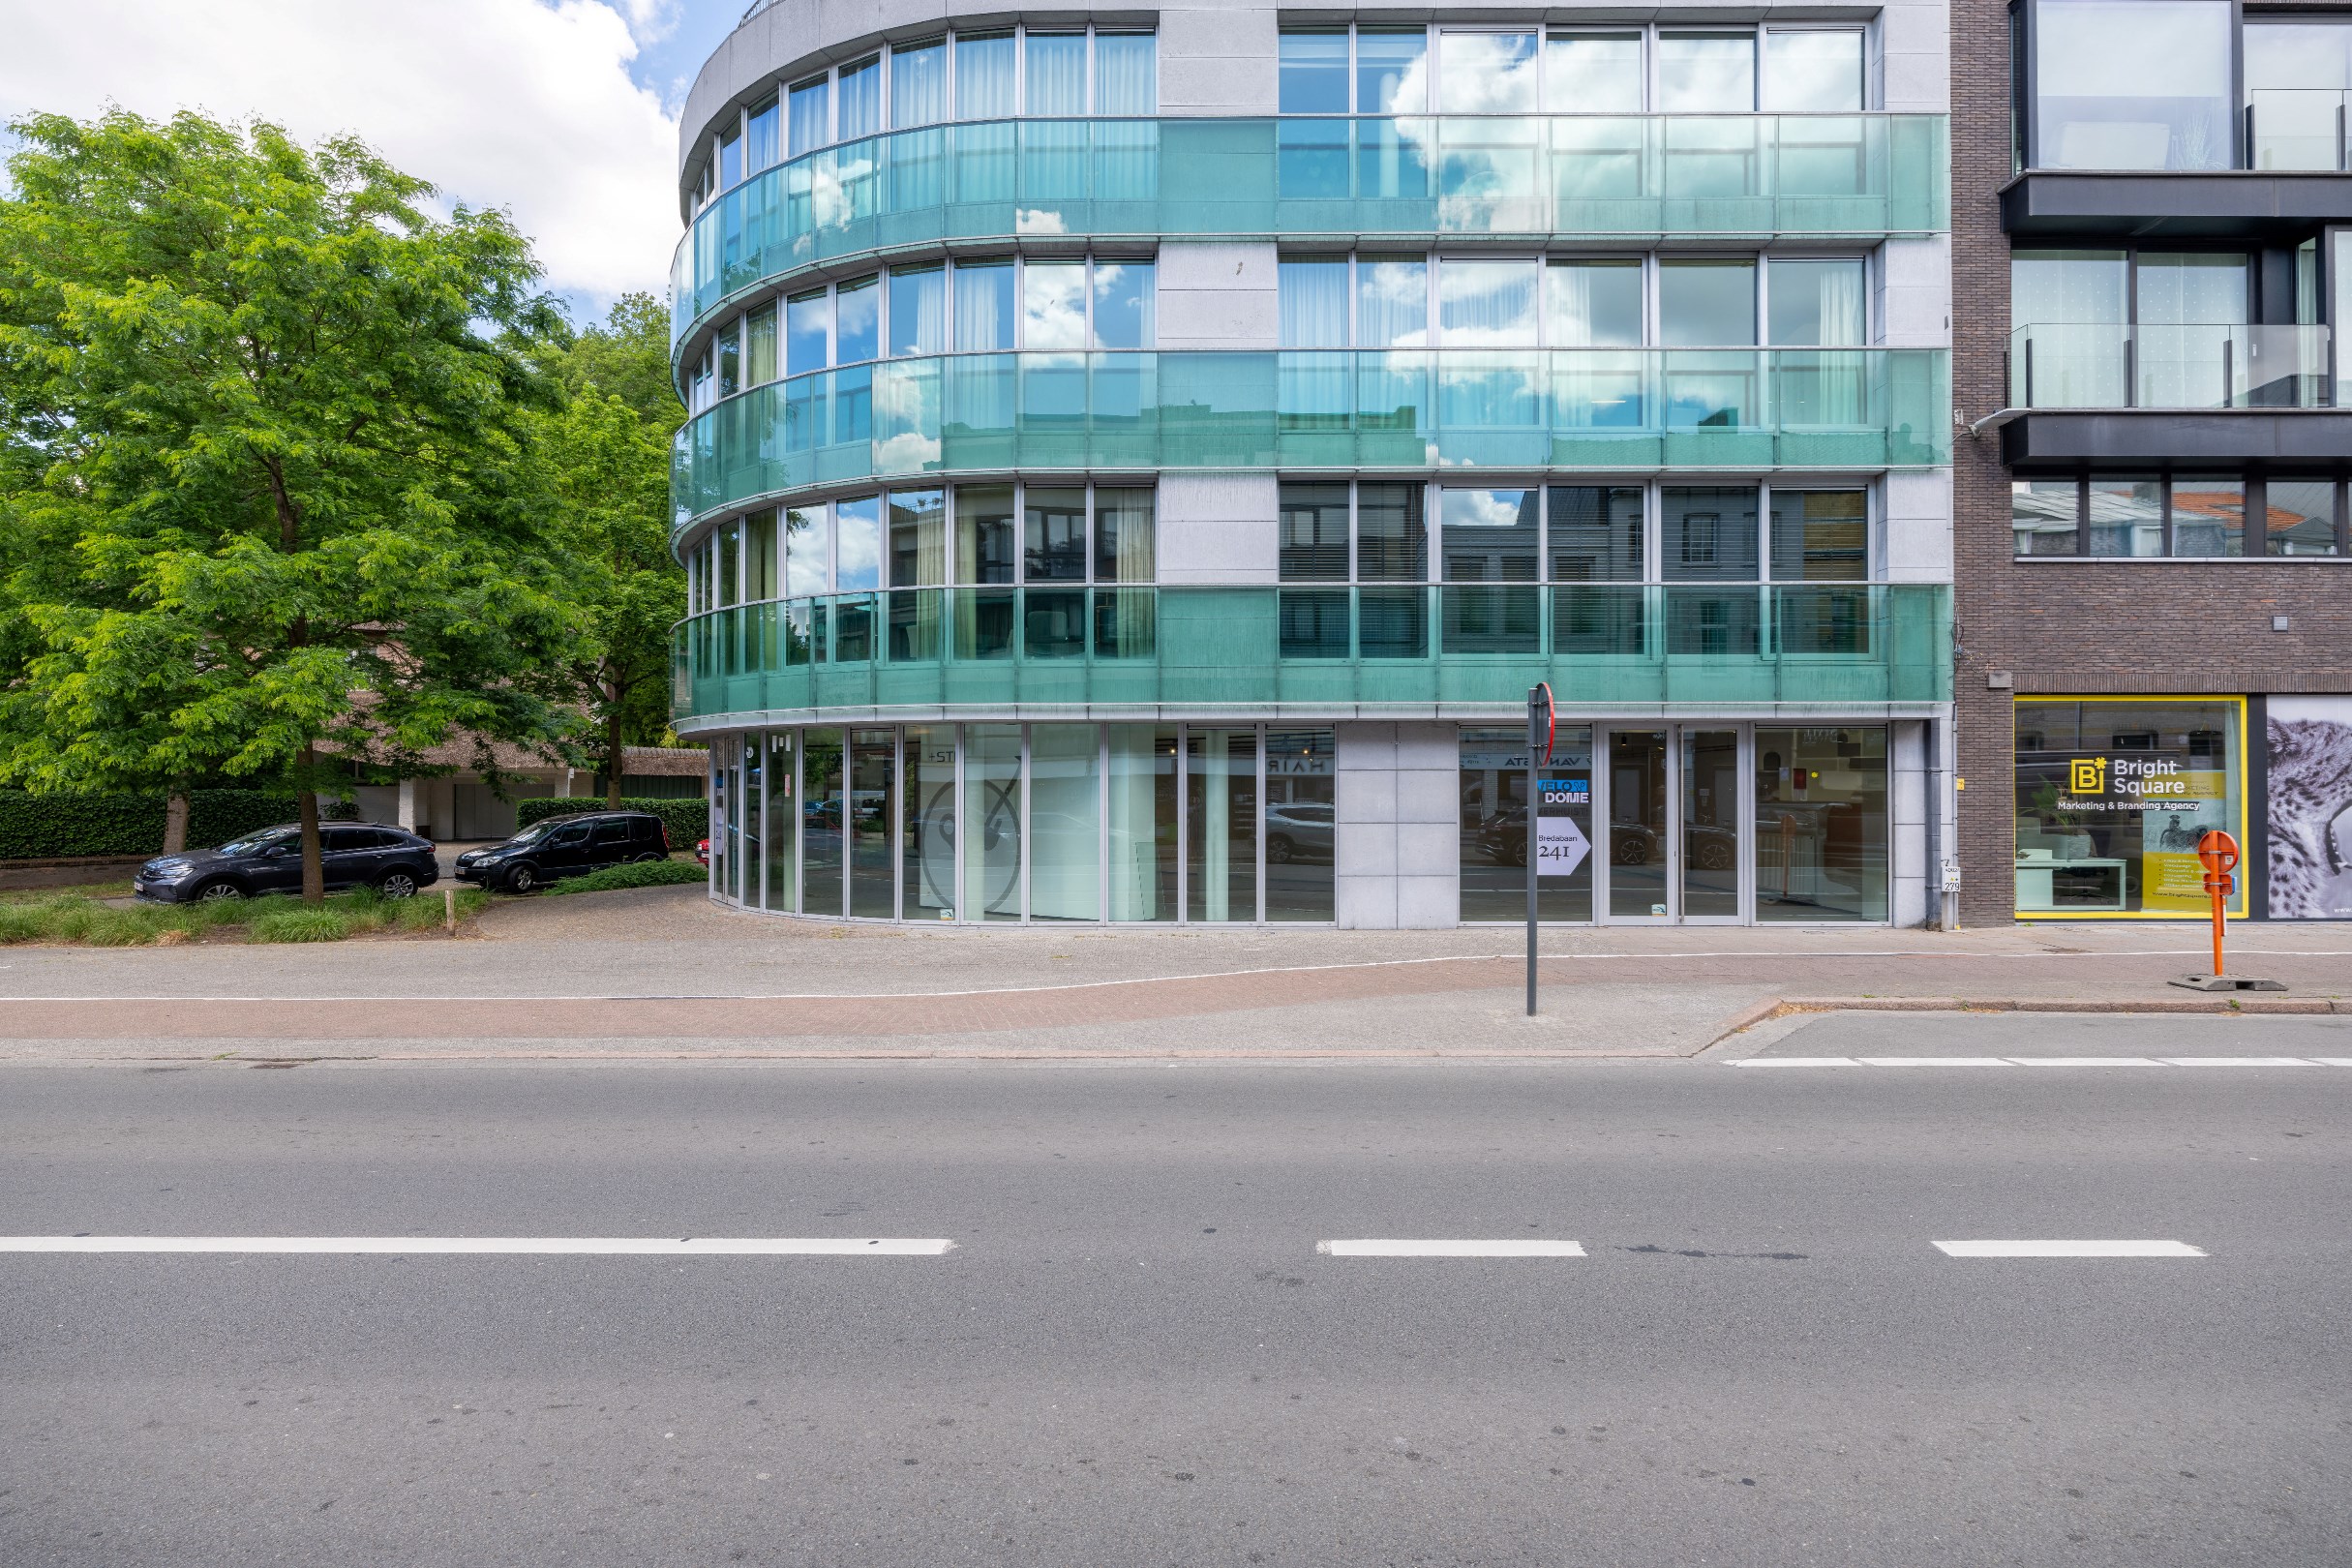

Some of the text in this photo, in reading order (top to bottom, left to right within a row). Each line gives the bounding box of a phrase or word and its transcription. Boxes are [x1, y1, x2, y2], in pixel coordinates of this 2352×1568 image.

[2114, 759, 2177, 778] Bright
[2114, 777, 2185, 796] Square
[1545, 792, 1589, 803] DOME
[2058, 801, 2105, 810] Marketing
[2117, 801, 2160, 810] Branding
[2163, 801, 2200, 811] Agency
[1538, 845, 1570, 861] 241
[1945, 882, 1960, 890] 279
